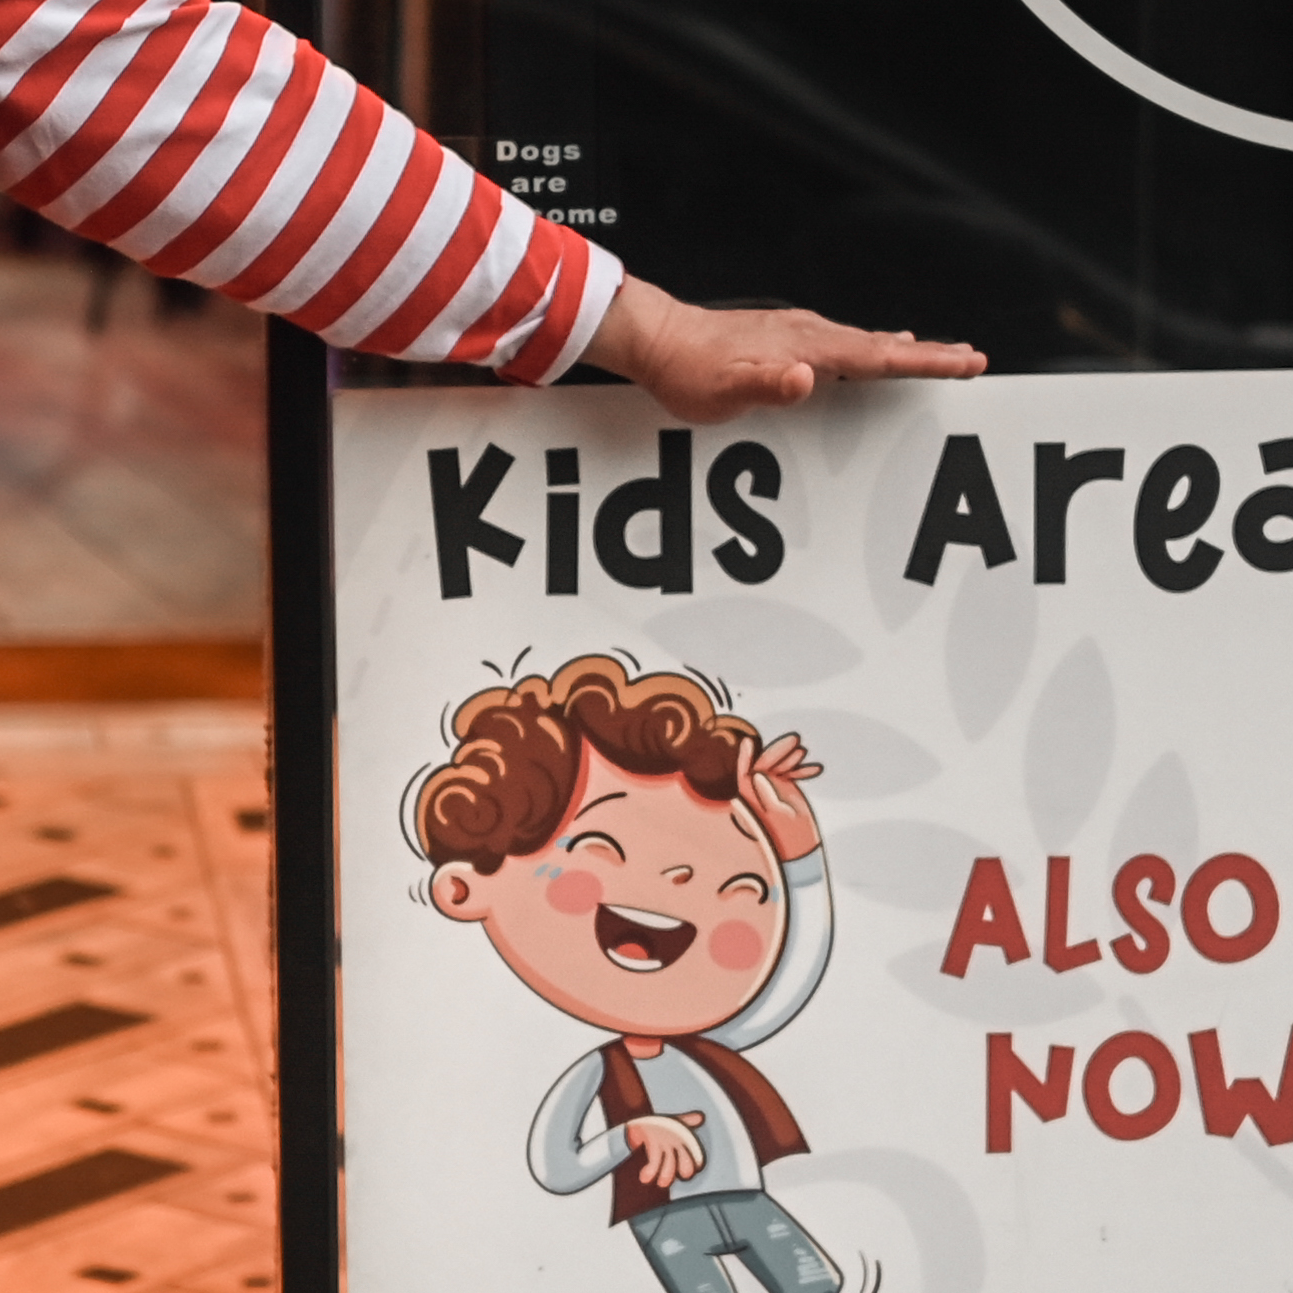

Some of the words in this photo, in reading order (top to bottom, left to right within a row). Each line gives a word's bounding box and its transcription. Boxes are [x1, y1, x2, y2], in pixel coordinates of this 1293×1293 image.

[496, 140, 581, 166] Dogs
[510, 176, 567, 193] are
[426, 428, 786, 601] Kids
[939, 851, 1280, 980] ALSO
